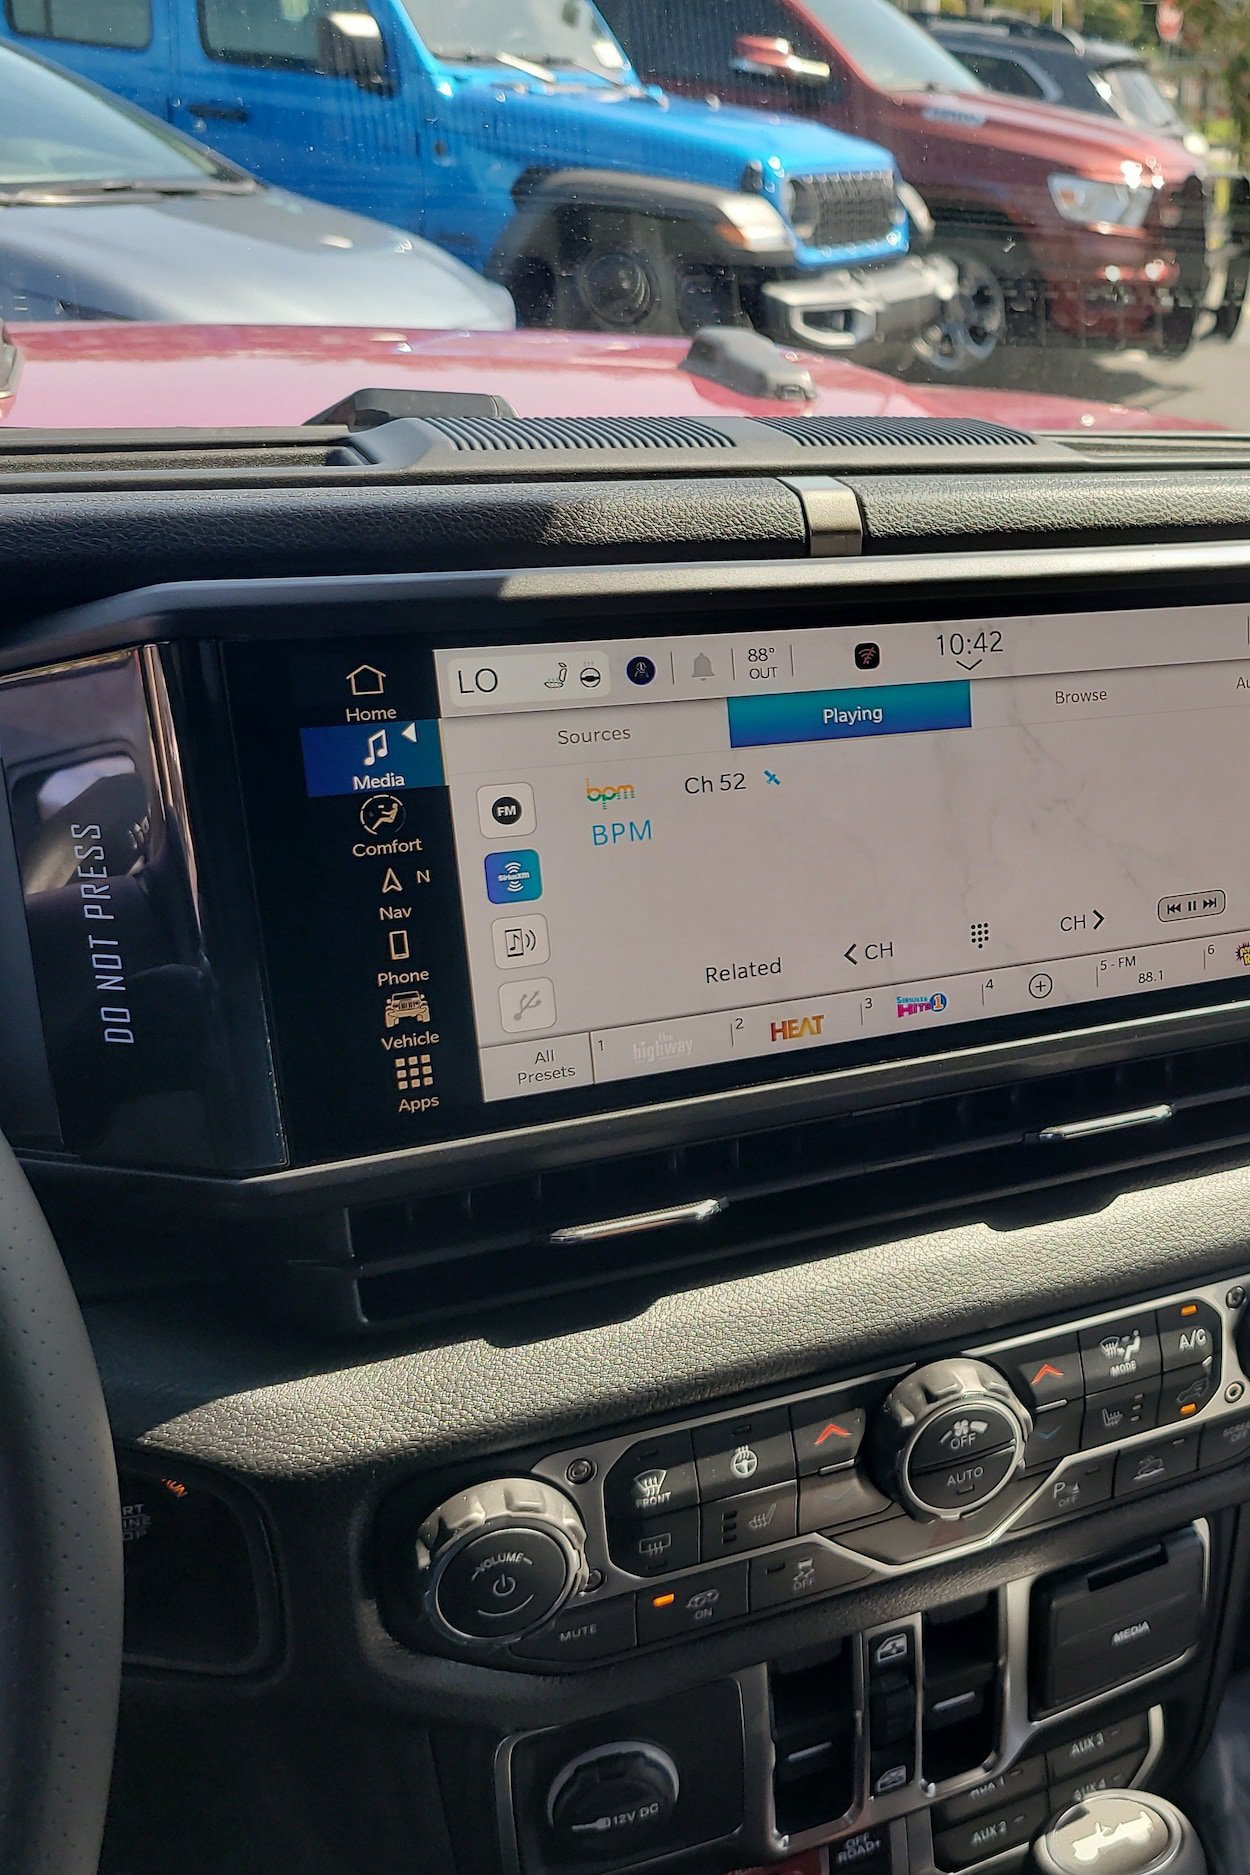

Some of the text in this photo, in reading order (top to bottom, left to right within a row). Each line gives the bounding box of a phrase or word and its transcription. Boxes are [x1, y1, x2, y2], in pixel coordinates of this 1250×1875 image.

[936, 631, 1004, 657] 10:42
[747, 648, 775, 663] 88°
[457, 667, 499, 694] LO
[749, 666, 778, 680] OUT
[1055, 687, 1108, 705] Browse
[346, 705, 397, 722] Home
[823, 706, 884, 726] Playing
[557, 726, 631, 745] Sources
[353, 773, 406, 790] Media
[684, 773, 747, 795] Ch 52
[585, 778, 635, 810] bpm
[497, 805, 517, 817] FM
[592, 820, 653, 846] BPM
[352, 837, 423, 858] Comfort
[417, 869, 430, 883] N
[379, 905, 412, 921] Nav
[1060, 915, 1086, 932] CH
[71, 823, 135, 1044] DO NOT PRESS
[864, 941, 894, 961] CH
[1207, 944, 1215, 955] 6
[705, 957, 782, 985] Related
[1100, 961, 1107, 971] 5
[1118, 956, 1136, 969] FM
[377, 968, 430, 987] Phone
[985, 979, 994, 990] 4
[1138, 971, 1165, 984] 88.1
[865, 998, 873, 1010] 3
[735, 1018, 744, 1030] 2
[770, 1014, 825, 1042] HEAT
[381, 1030, 440, 1050] Vehicle
[598, 1039, 605, 1051] 1
[534, 1048, 555, 1066] All
[633, 1039, 694, 1062] highway
[517, 1064, 577, 1086] Presets
[398, 1094, 440, 1115] Apps
[1178, 1328, 1206, 1351] A/C
[1109, 1360, 1137, 1378] MODE
[950, 1432, 977, 1450] OFF
[946, 1466, 984, 1487] AUTO
[634, 1491, 672, 1510] FRONT
[475, 1552, 525, 1572] VOLUME
[694, 1607, 713, 1620] ON
[559, 1624, 597, 1643] MUTE
[1110, 1621, 1151, 1646] MEDIA
[1070, 1732, 1105, 1758] AUX 3
[613, 1803, 659, 1826] 12V DC
[846, 1832, 872, 1849] OFF
[970, 1820, 1008, 1846] AUX 2
